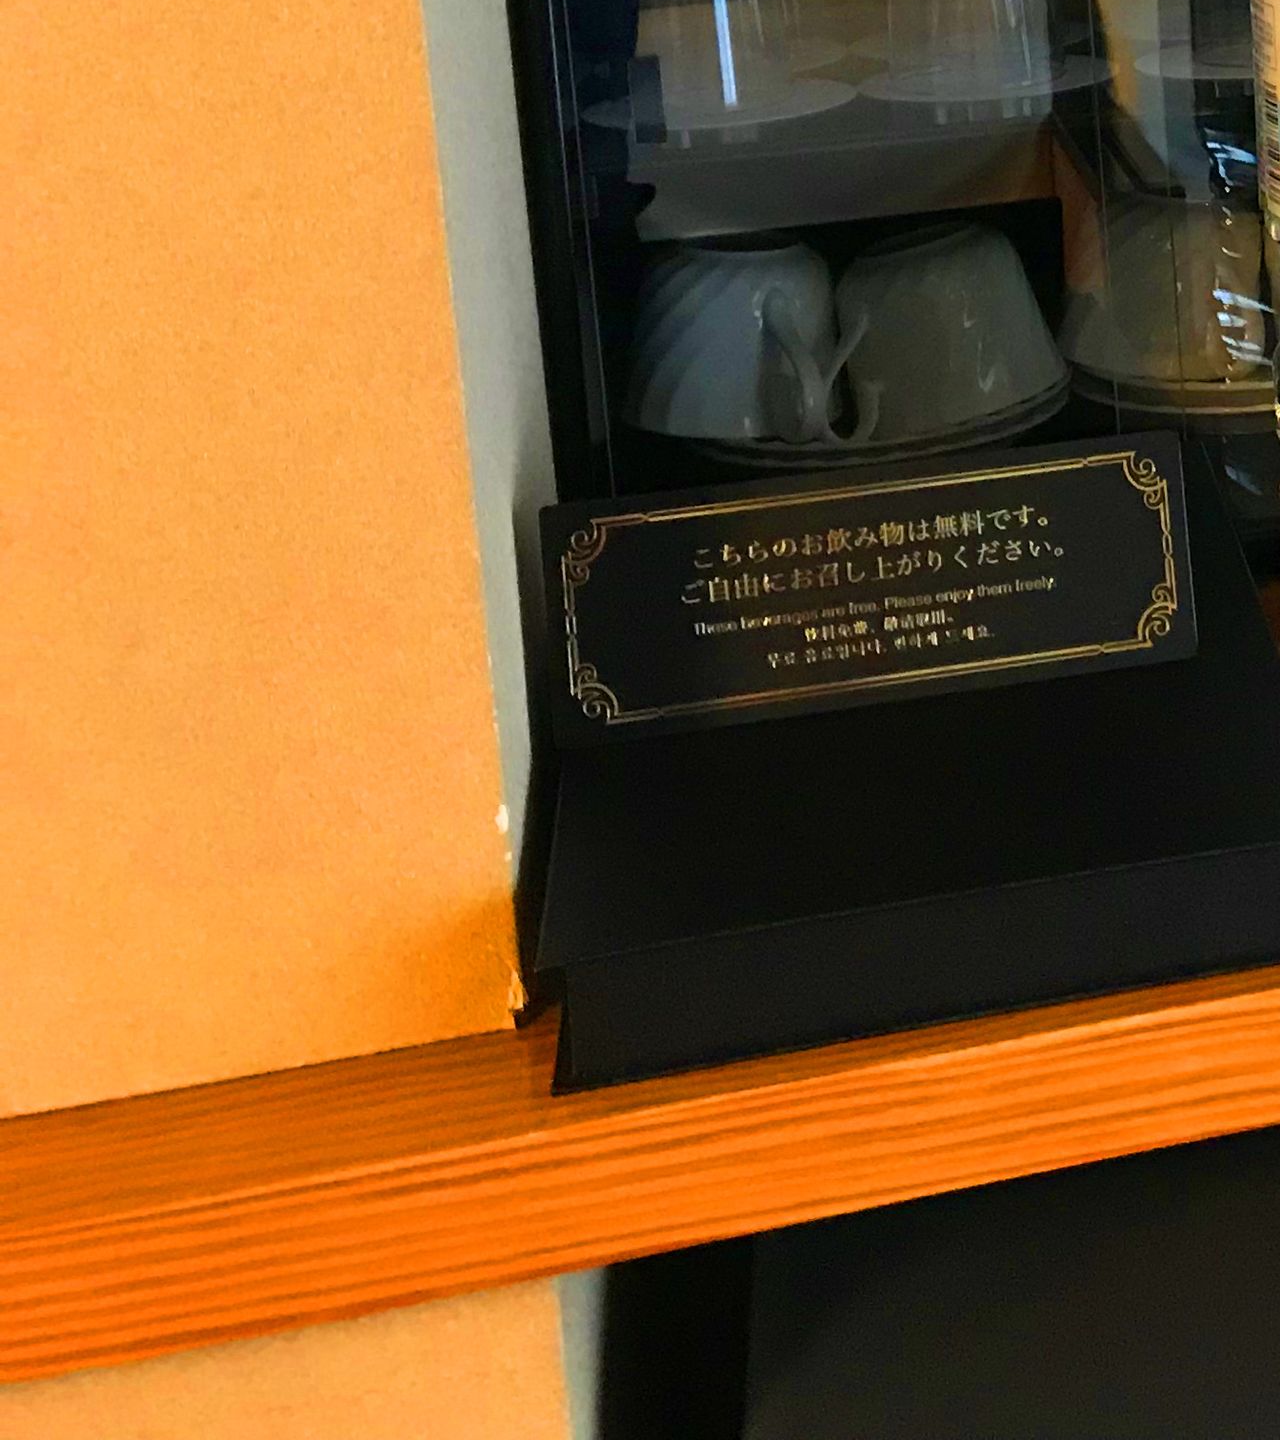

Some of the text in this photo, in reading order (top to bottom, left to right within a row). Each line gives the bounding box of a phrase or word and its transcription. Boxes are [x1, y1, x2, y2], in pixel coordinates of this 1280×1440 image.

[693, 504, 1049, 571] こちらのお飲み物は無料です。
[680, 538, 1064, 605] ご自由にお召し上がりください。
[884, 593, 932, 610] Please
[935, 588, 974, 604] enjoy
[977, 582, 1013, 598] them
